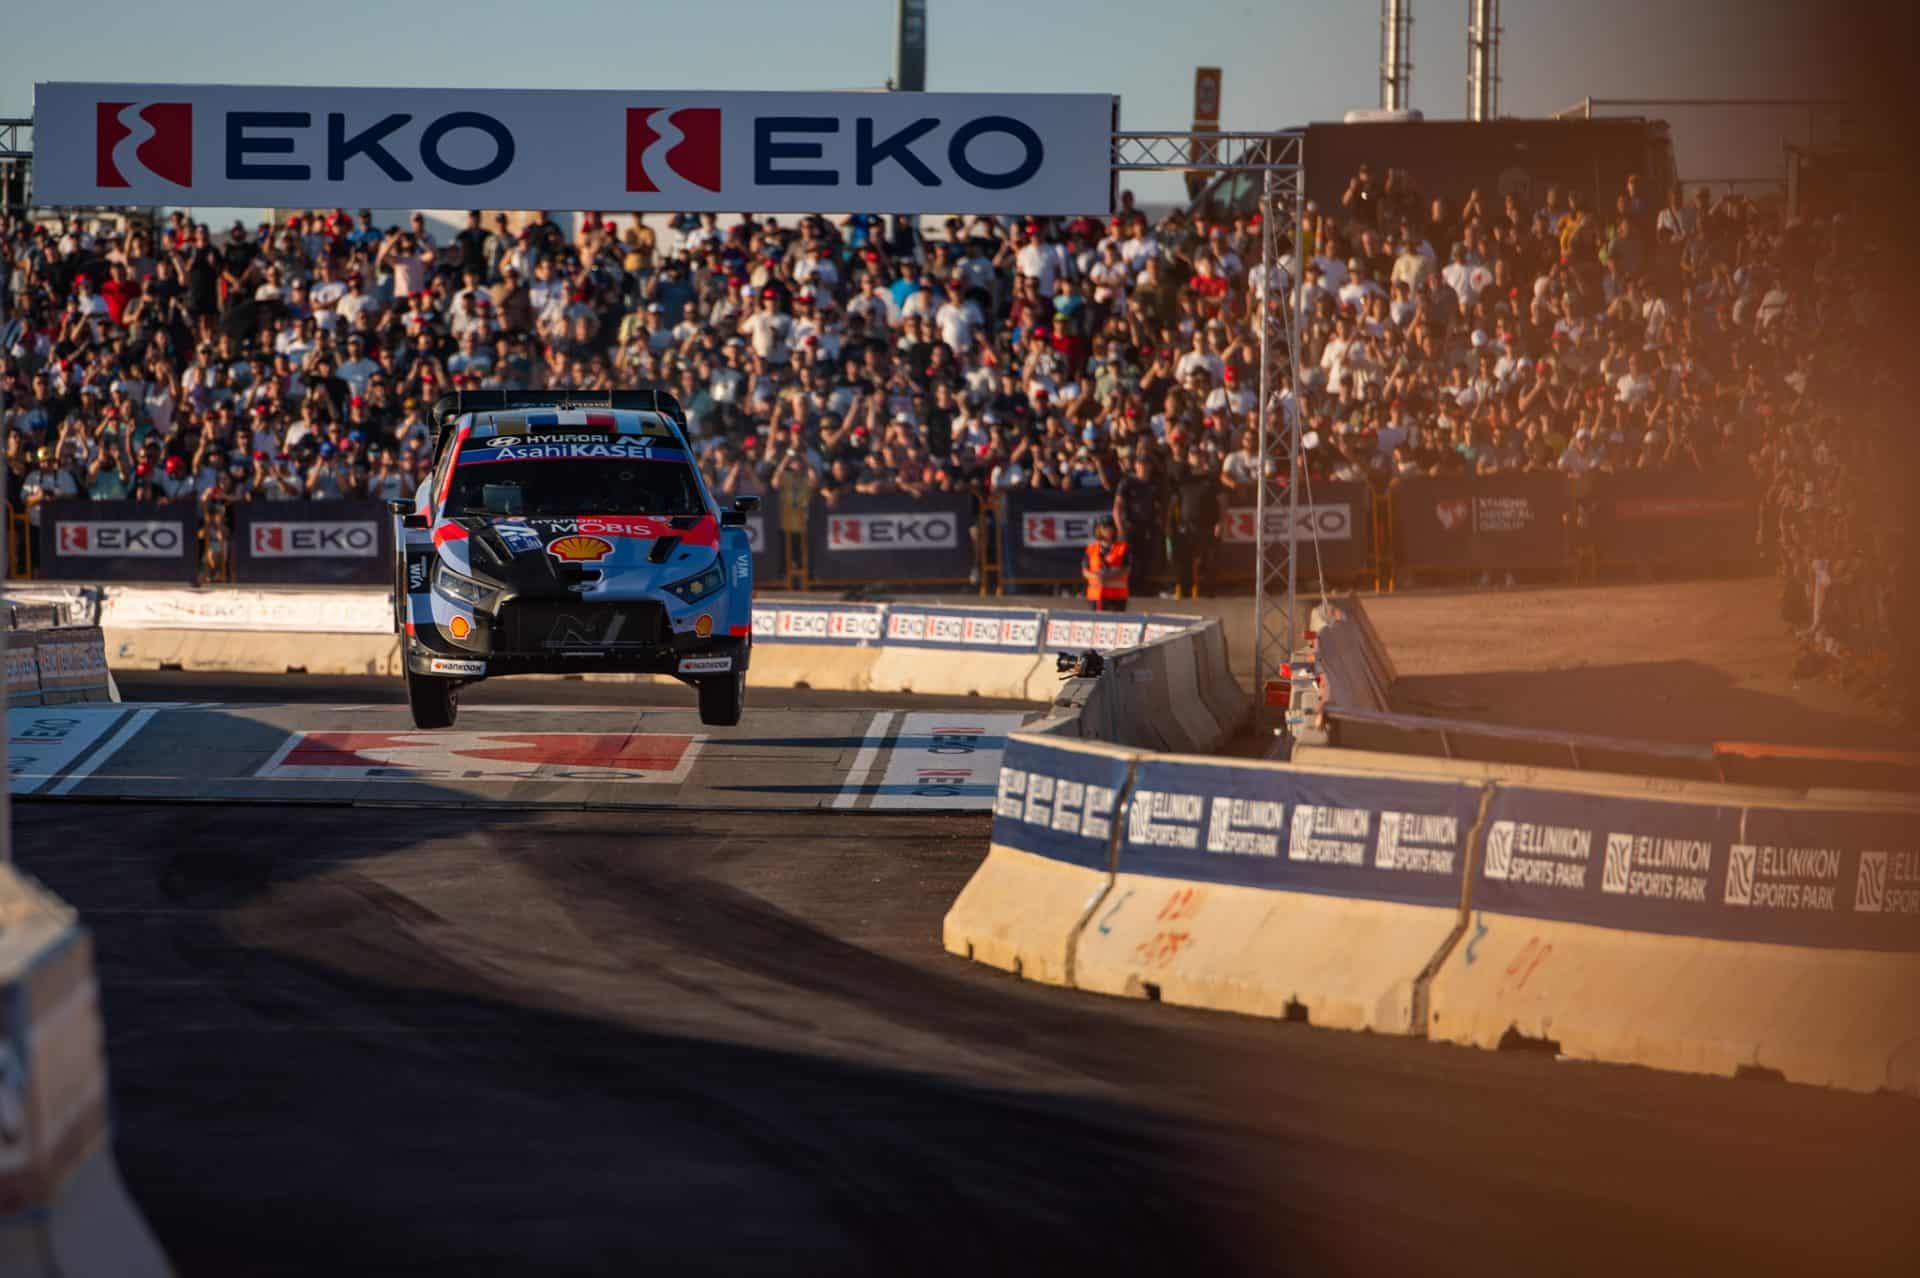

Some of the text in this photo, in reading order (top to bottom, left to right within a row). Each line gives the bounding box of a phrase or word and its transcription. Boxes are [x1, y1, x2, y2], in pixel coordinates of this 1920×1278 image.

[226, 111, 515, 185] EKO
[755, 116, 1044, 190] EKO
[97, 528, 178, 550] EKO
[291, 528, 372, 550] EKO
[551, 523, 652, 535] MOBIS
[869, 519, 952, 543] EKO
[1519, 823, 1591, 859] ELLINIKON
[1638, 836, 1712, 872] ELLINIKON
[1509, 856, 1587, 889] SPORTS PARK
[1761, 846, 1841, 880] ELLINIKON
[1629, 871, 1708, 903] SPORTS PARK
[1753, 882, 1836, 911] SPORTS PARK
